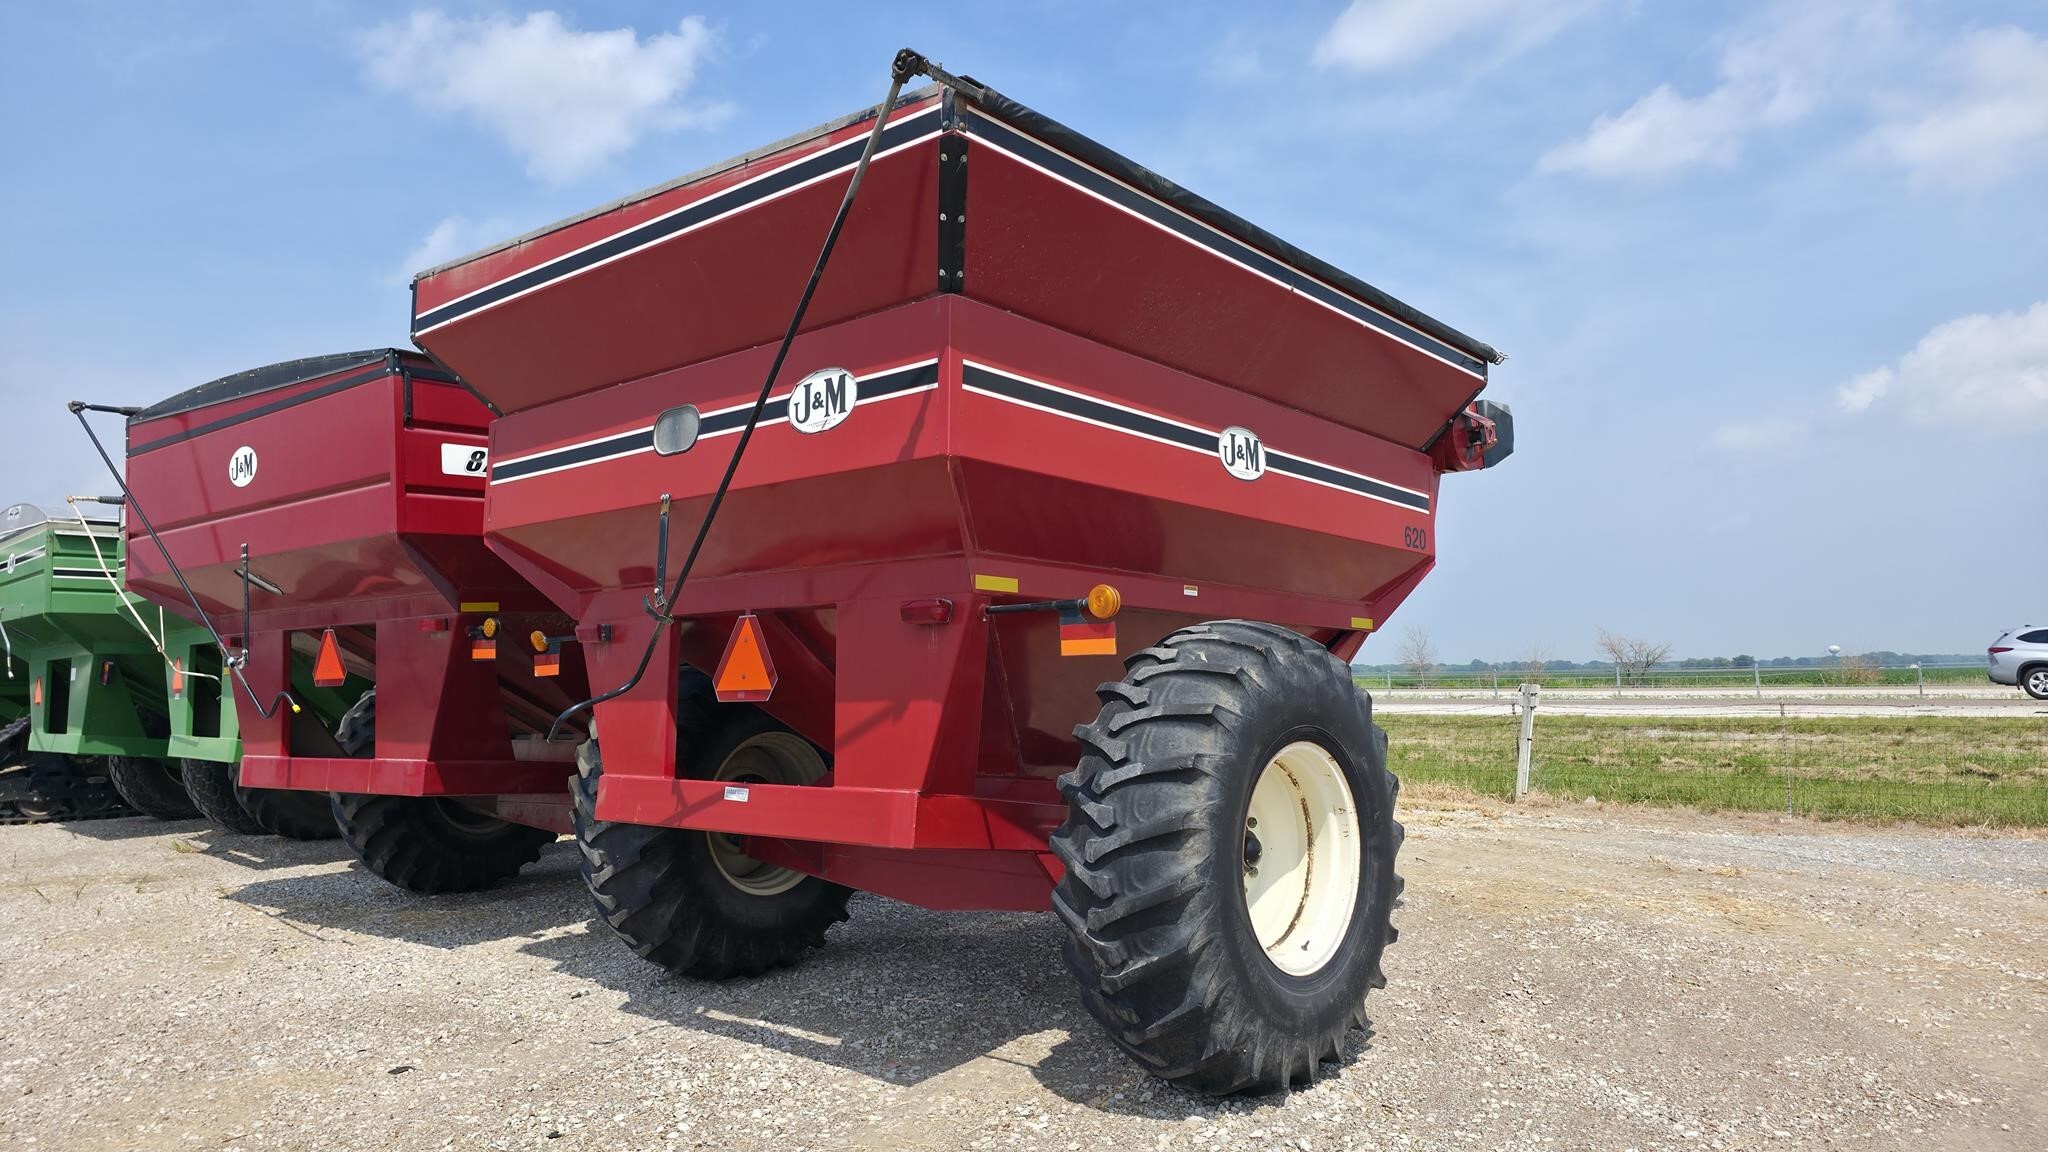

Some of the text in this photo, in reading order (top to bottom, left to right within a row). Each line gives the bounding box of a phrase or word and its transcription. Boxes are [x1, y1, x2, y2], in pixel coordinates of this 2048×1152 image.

[794, 374, 847, 424] J&M
[231, 452, 253, 481] J&M
[466, 450, 488, 472] 8
[1223, 433, 1260, 472] J&M
[1405, 526, 1426, 550] 620
